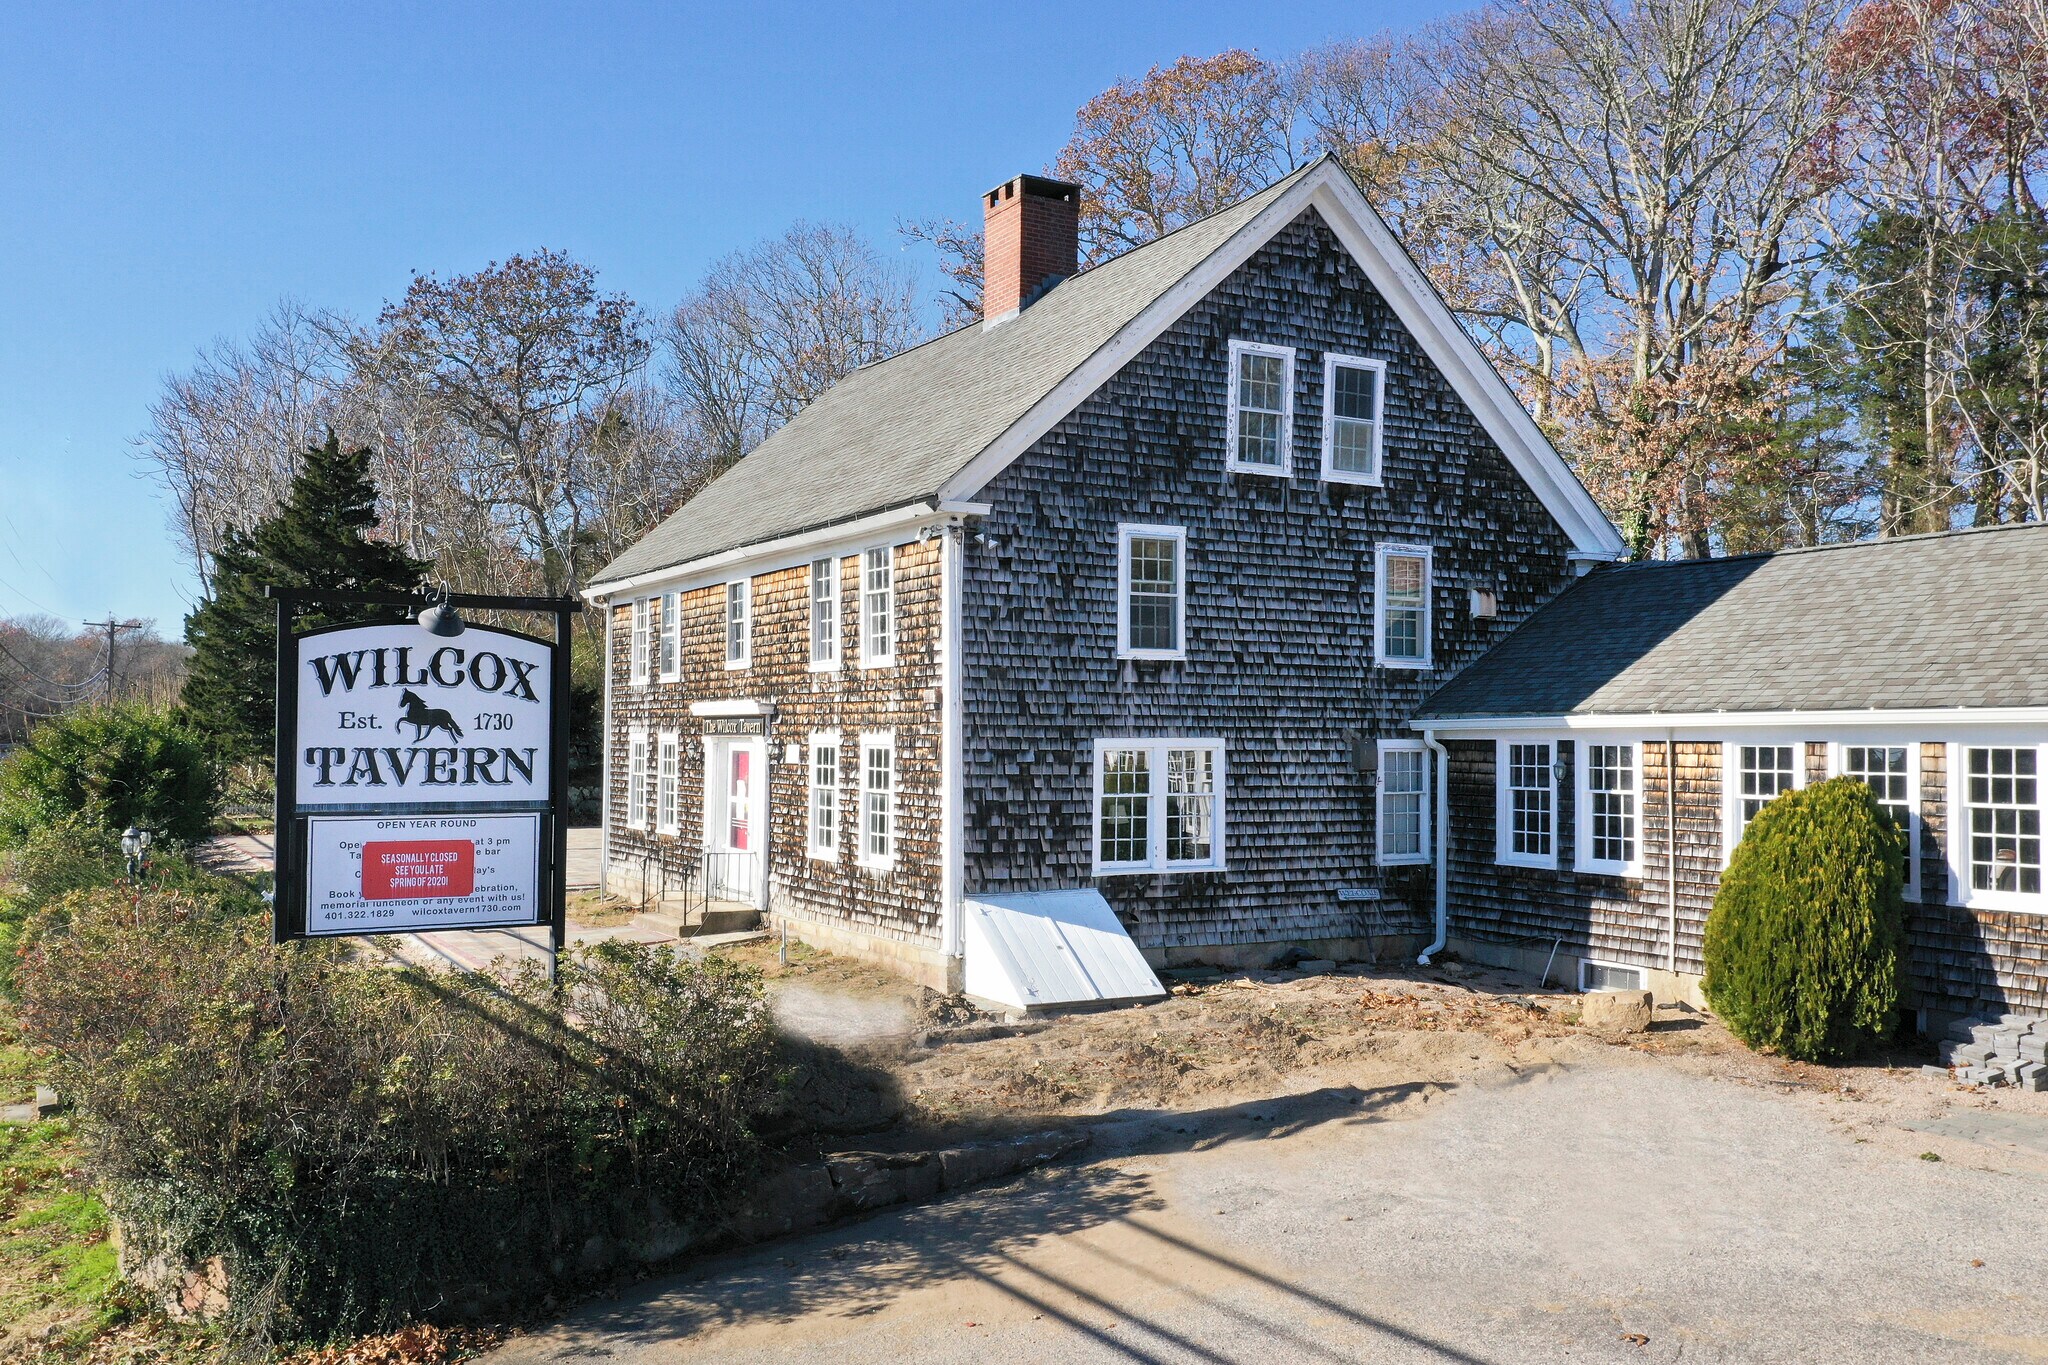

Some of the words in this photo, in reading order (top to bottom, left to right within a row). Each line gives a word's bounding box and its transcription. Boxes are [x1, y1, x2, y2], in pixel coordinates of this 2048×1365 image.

[308, 647, 540, 703] WILCOX
[338, 712, 382, 729] Est.
[474, 713, 513, 730] 1730
[705, 719, 717, 733] The
[717, 719, 738, 733] Wilcox
[739, 718, 760, 733] Tavern
[304, 747, 538, 787] TAVERN
[377, 821, 406, 829] OPEN
[410, 820, 437, 828] YEAR
[440, 819, 477, 828] ROUND
[339, 841, 362, 850] Ope
[496, 838, 510, 846] pm
[381, 853, 430, 864] SEASONALLY
[430, 852, 458, 862] CLOSED
[395, 865, 409, 875] SEE
[410, 865, 425, 874] YOU
[425, 864, 444, 874] LATE
[390, 877, 416, 888] SPRING
[417, 877, 426, 886] OF
[329, 890, 355, 898] Book
[321, 900, 369, 910] memorial
[372, 899, 419, 907] luncheon
[437, 897, 457, 906] any
[458, 896, 484, 904] event
[487, 894, 507, 902] with
[511, 893, 525, 901] us!
[325, 909, 395, 920] 401.322.1829
[412, 905, 521, 916] wilcoxtavern1730.com
